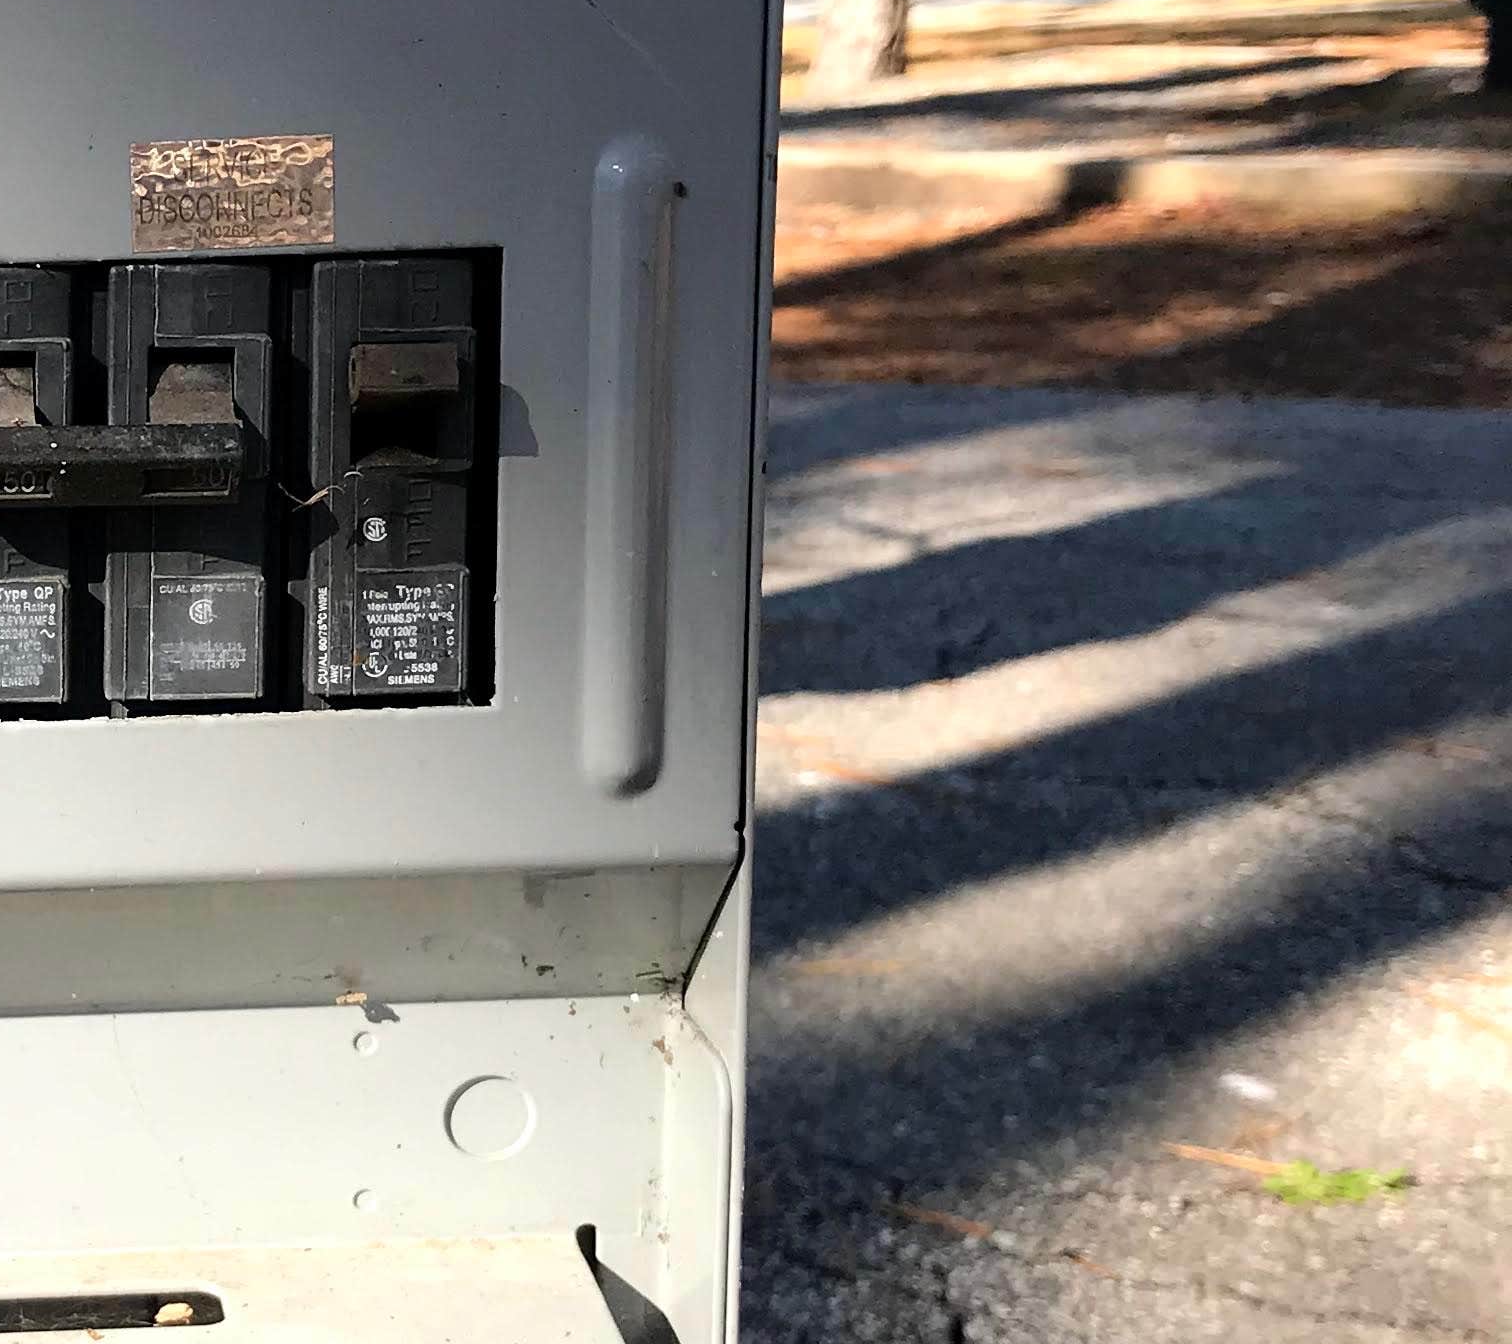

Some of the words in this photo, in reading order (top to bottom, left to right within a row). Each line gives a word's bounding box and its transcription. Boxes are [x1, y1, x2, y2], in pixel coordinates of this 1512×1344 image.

[139, 188, 314, 226] DISCONNECTS
[3, 470, 36, 494] 50
[33, 586, 54, 600] QP
[317, 586, 329, 611] WIRE
[395, 584, 432, 603] Type
[317, 652, 329, 685] CU/AL
